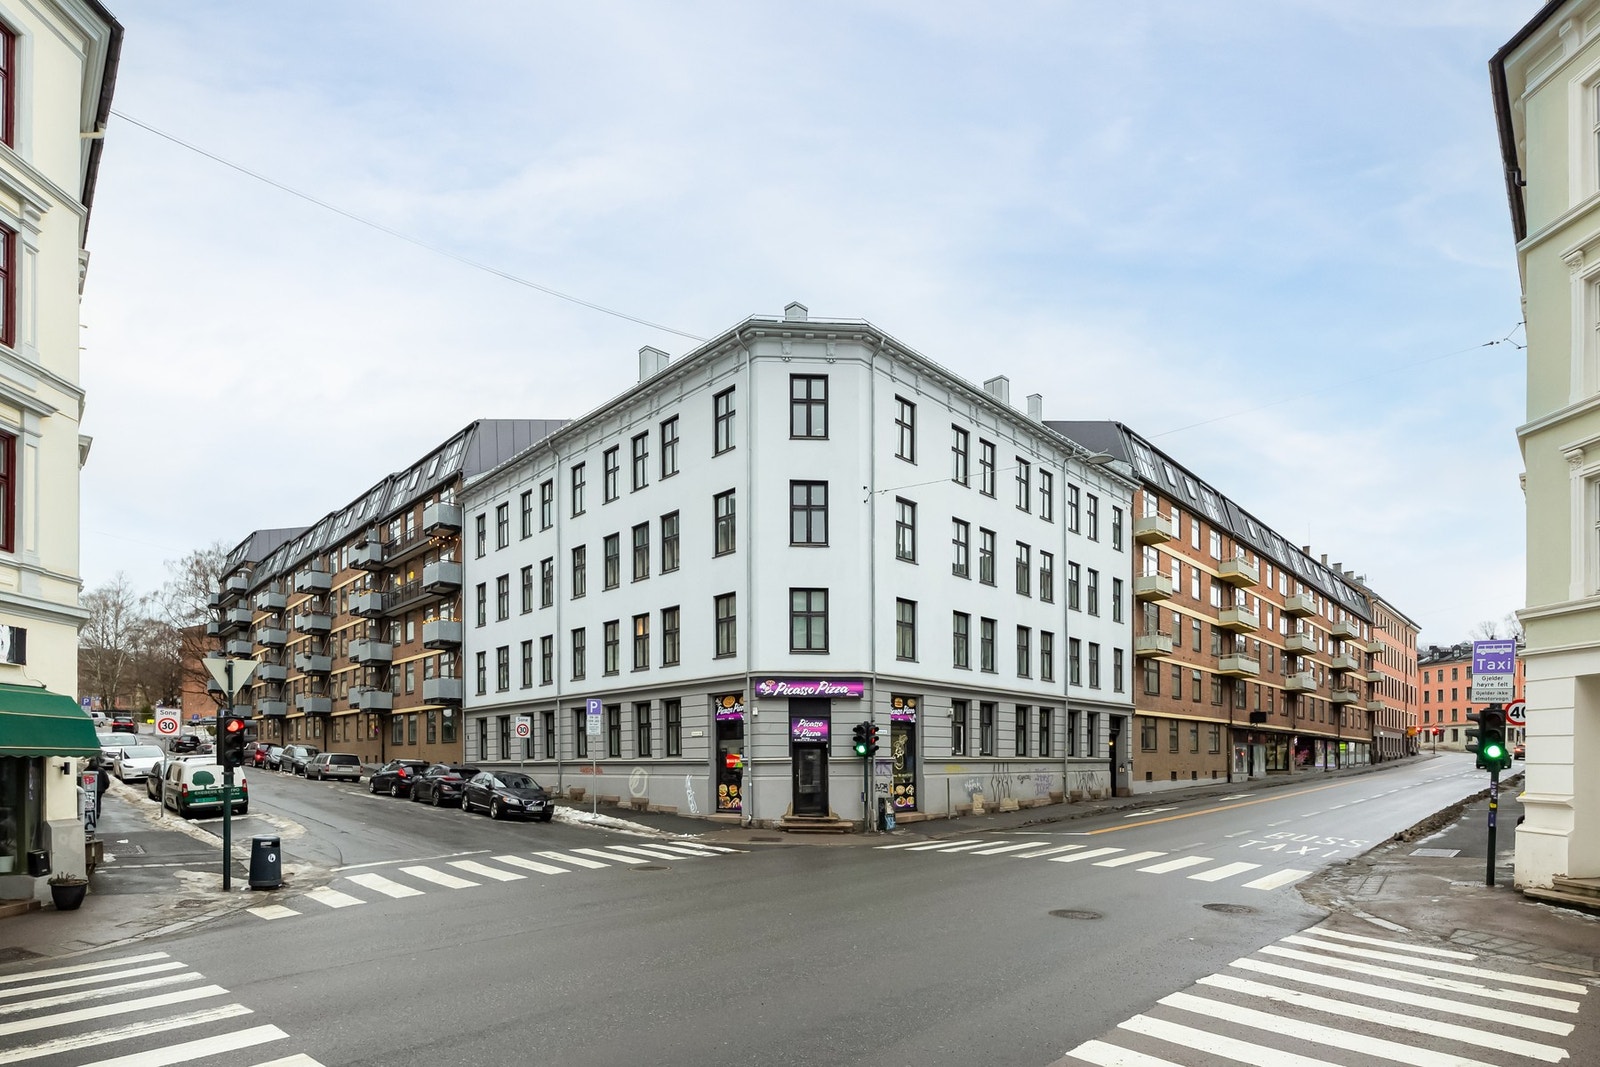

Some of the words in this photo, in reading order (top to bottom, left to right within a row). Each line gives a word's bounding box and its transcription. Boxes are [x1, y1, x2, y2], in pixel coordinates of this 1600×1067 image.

[1476, 658, 1511, 670] Taxi
[773, 682, 815, 696] Picasso
[815, 680, 849, 694] Pizza
[590, 701, 598, 713] P
[161, 721, 174, 730] 30
[797, 719, 823, 728] Picasso
[800, 729, 821, 737] Pizza
[1264, 832, 1370, 848] BUSS
[1239, 840, 1341, 858] TAXI
